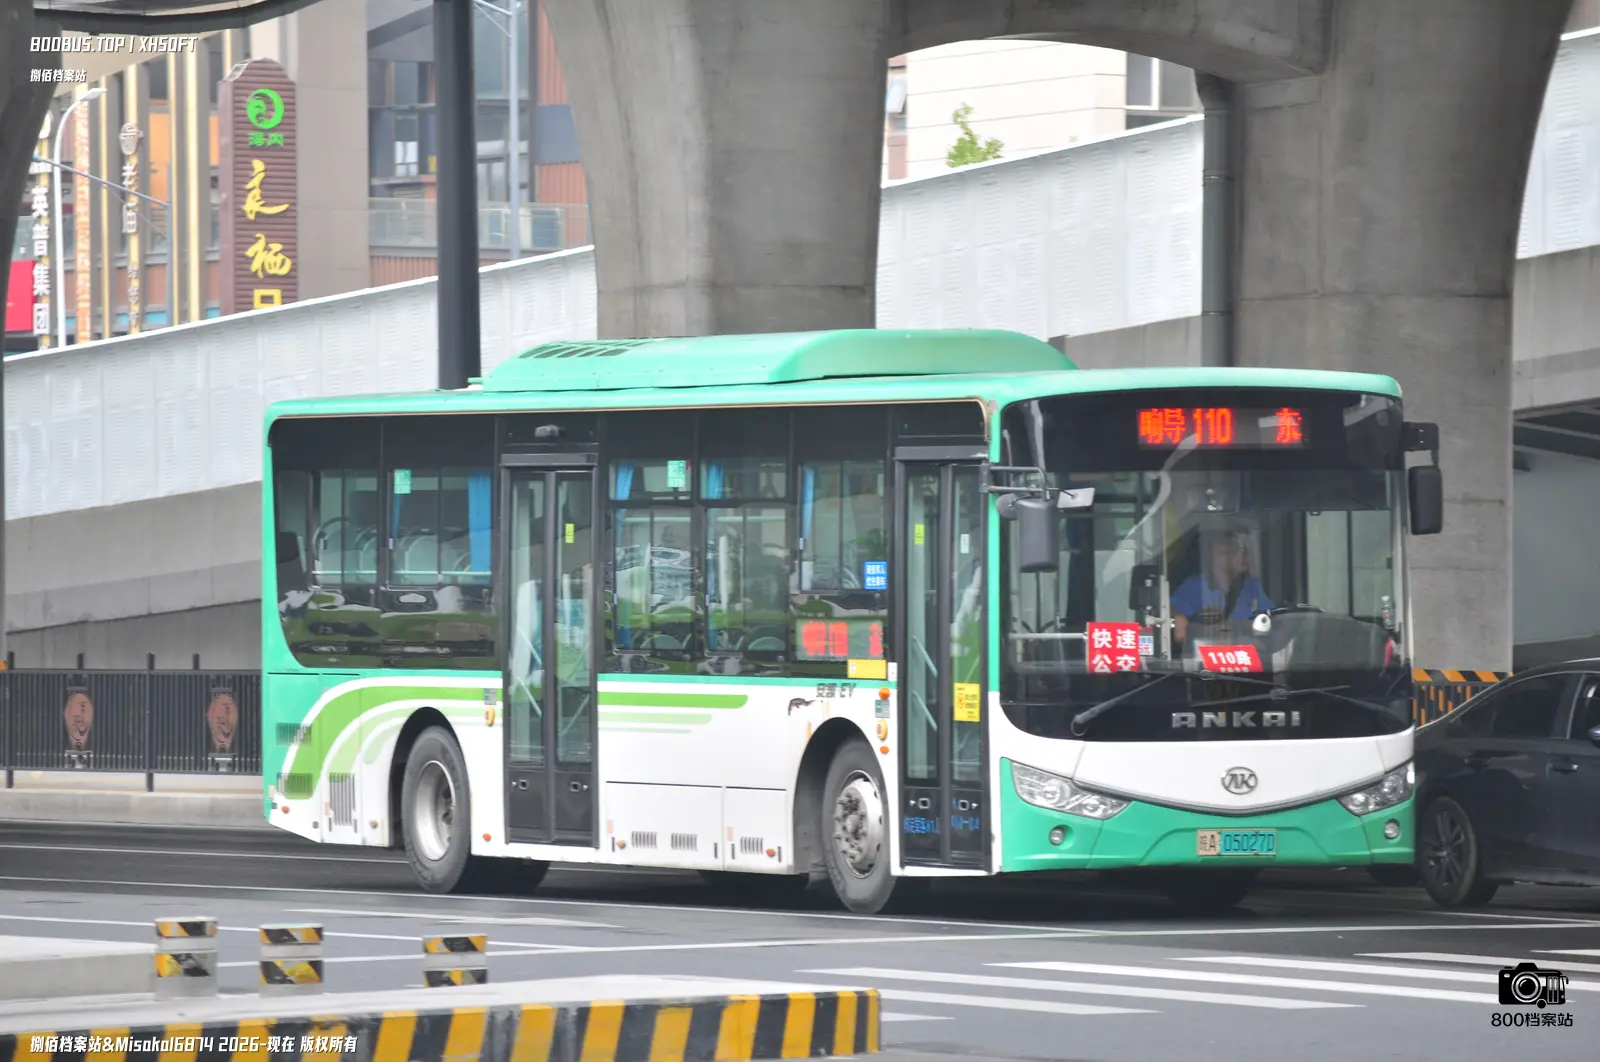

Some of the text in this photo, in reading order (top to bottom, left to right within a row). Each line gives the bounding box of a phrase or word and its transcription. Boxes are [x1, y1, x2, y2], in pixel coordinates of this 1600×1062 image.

[1192, 408, 1232, 444] 110
[1091, 628, 1137, 650] 快速
[1091, 654, 1137, 674] 公交
[1207, 651, 1253, 666] 110路
[1171, 711, 1301, 729] ANKAI
